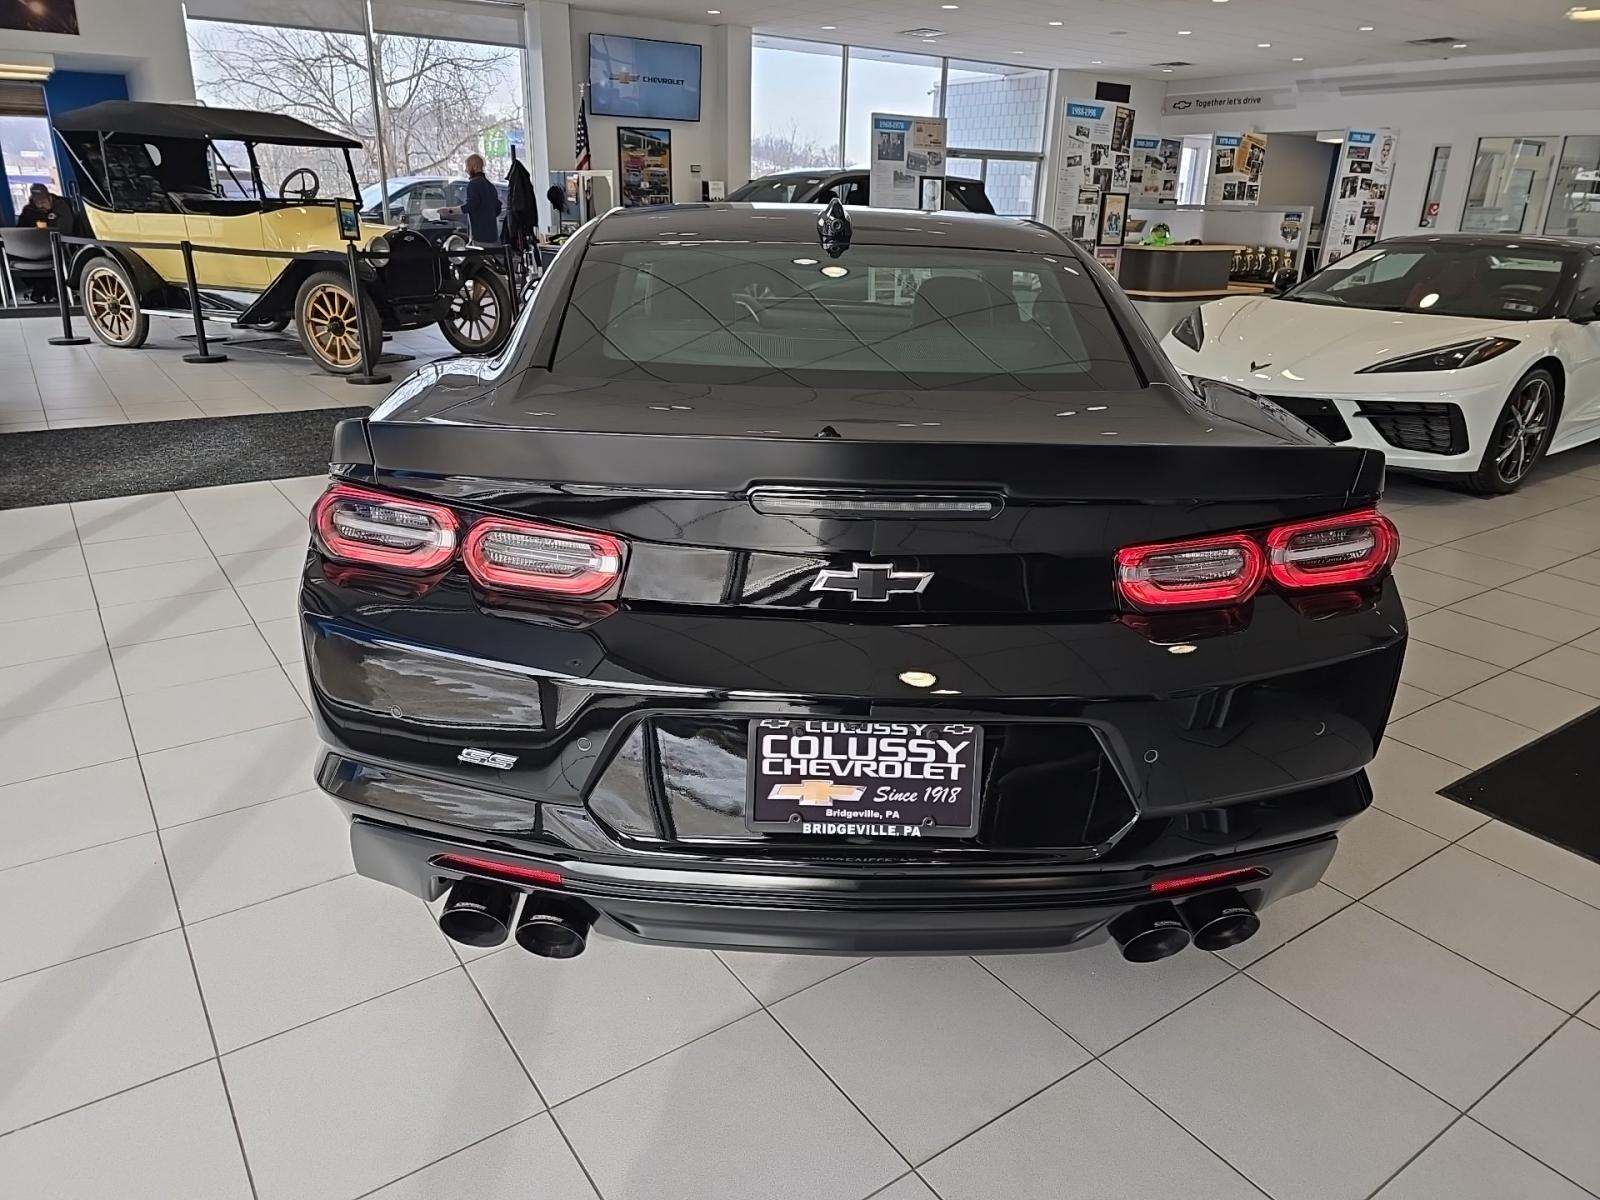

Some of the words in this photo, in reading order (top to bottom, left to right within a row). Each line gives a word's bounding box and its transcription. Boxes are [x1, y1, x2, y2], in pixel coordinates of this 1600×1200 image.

[642, 75, 685, 86] CHEVROLET
[1195, 98, 1226, 109] Together
[1227, 97, 1242, 106] let's
[1243, 96, 1262, 105] drive
[761, 734, 970, 764] COLUSSY
[457, 748, 519, 770] SS
[762, 758, 967, 781] CHEVROLET
[873, 785, 920, 804] Since
[923, 785, 963, 804] 1918
[825, 808, 883, 820] Bridgeville,
[885, 810, 900, 819] PA
[903, 825, 922, 837] PA
